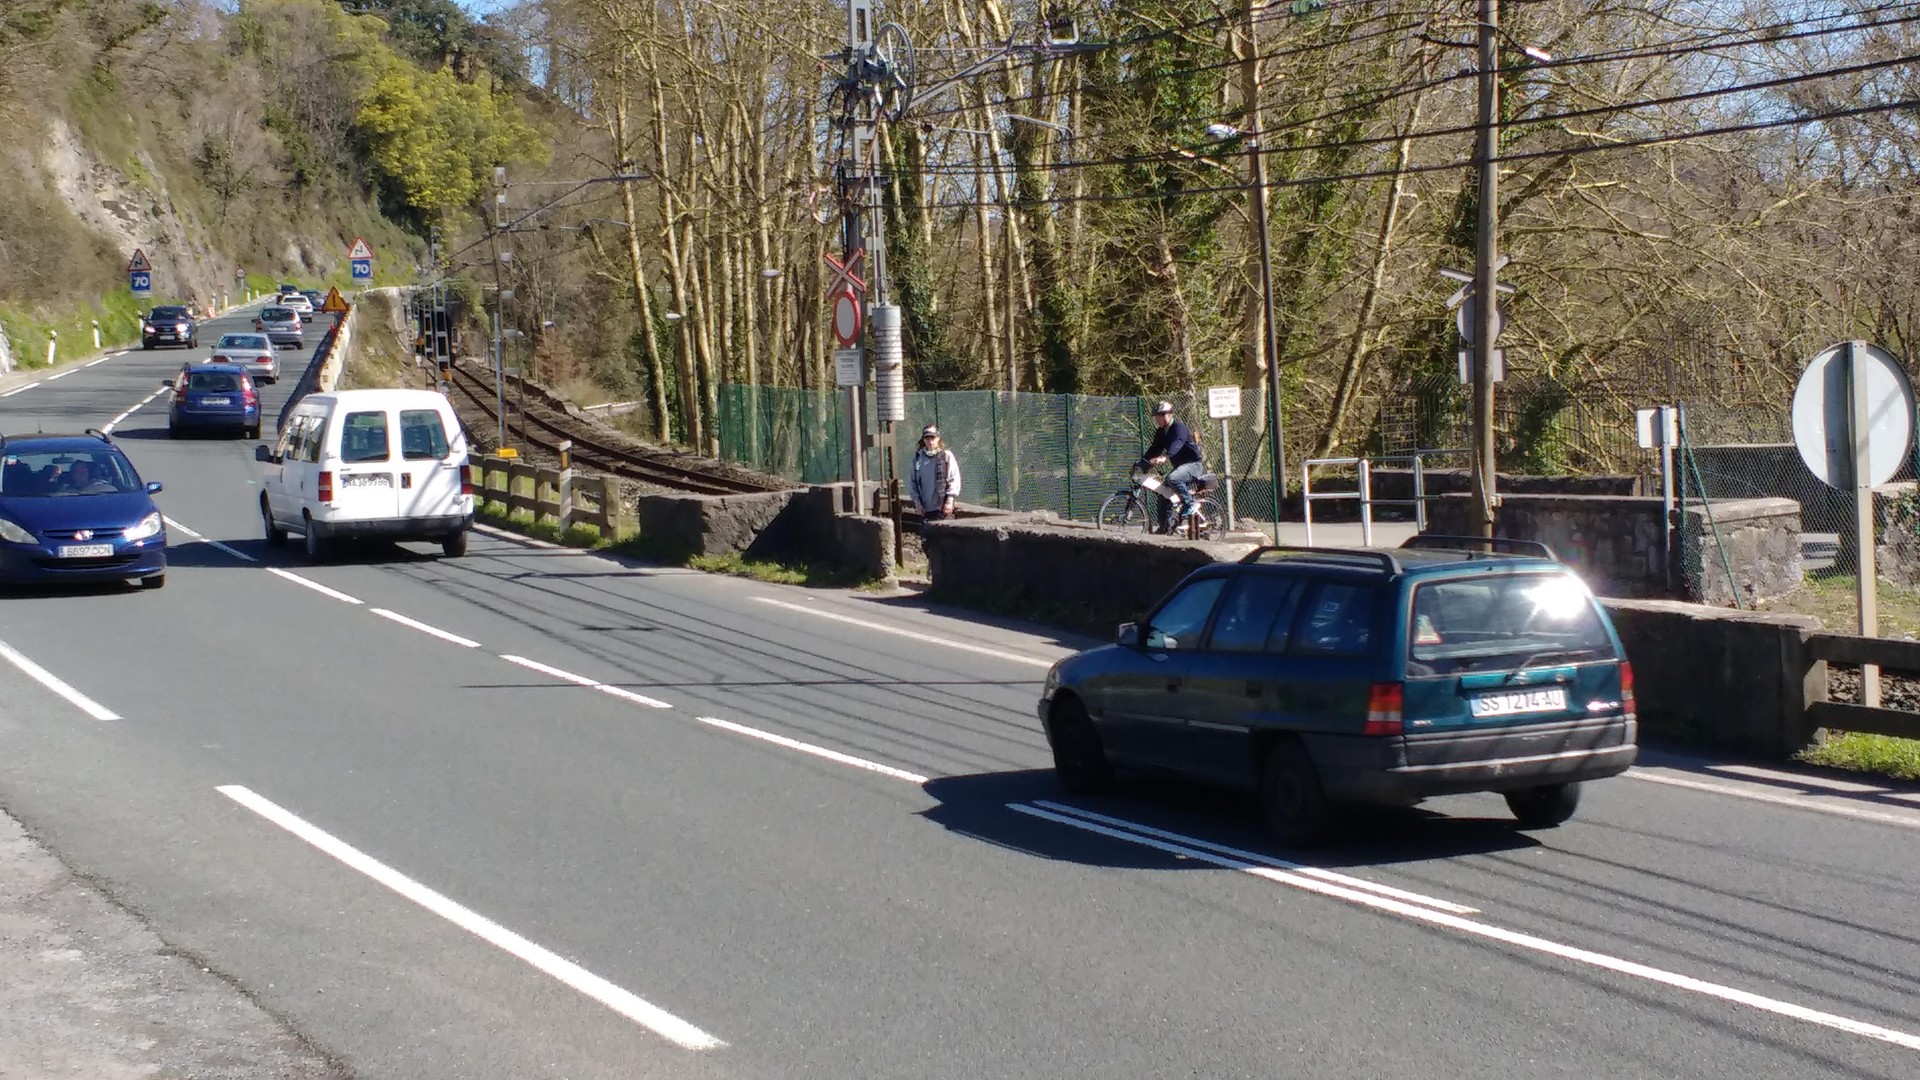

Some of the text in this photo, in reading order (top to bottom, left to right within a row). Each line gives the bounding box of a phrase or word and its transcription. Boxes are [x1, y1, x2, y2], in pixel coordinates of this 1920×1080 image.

[353, 263, 370, 275] 70
[133, 275, 149, 287] 70
[1480, 695, 1500, 711] SS
